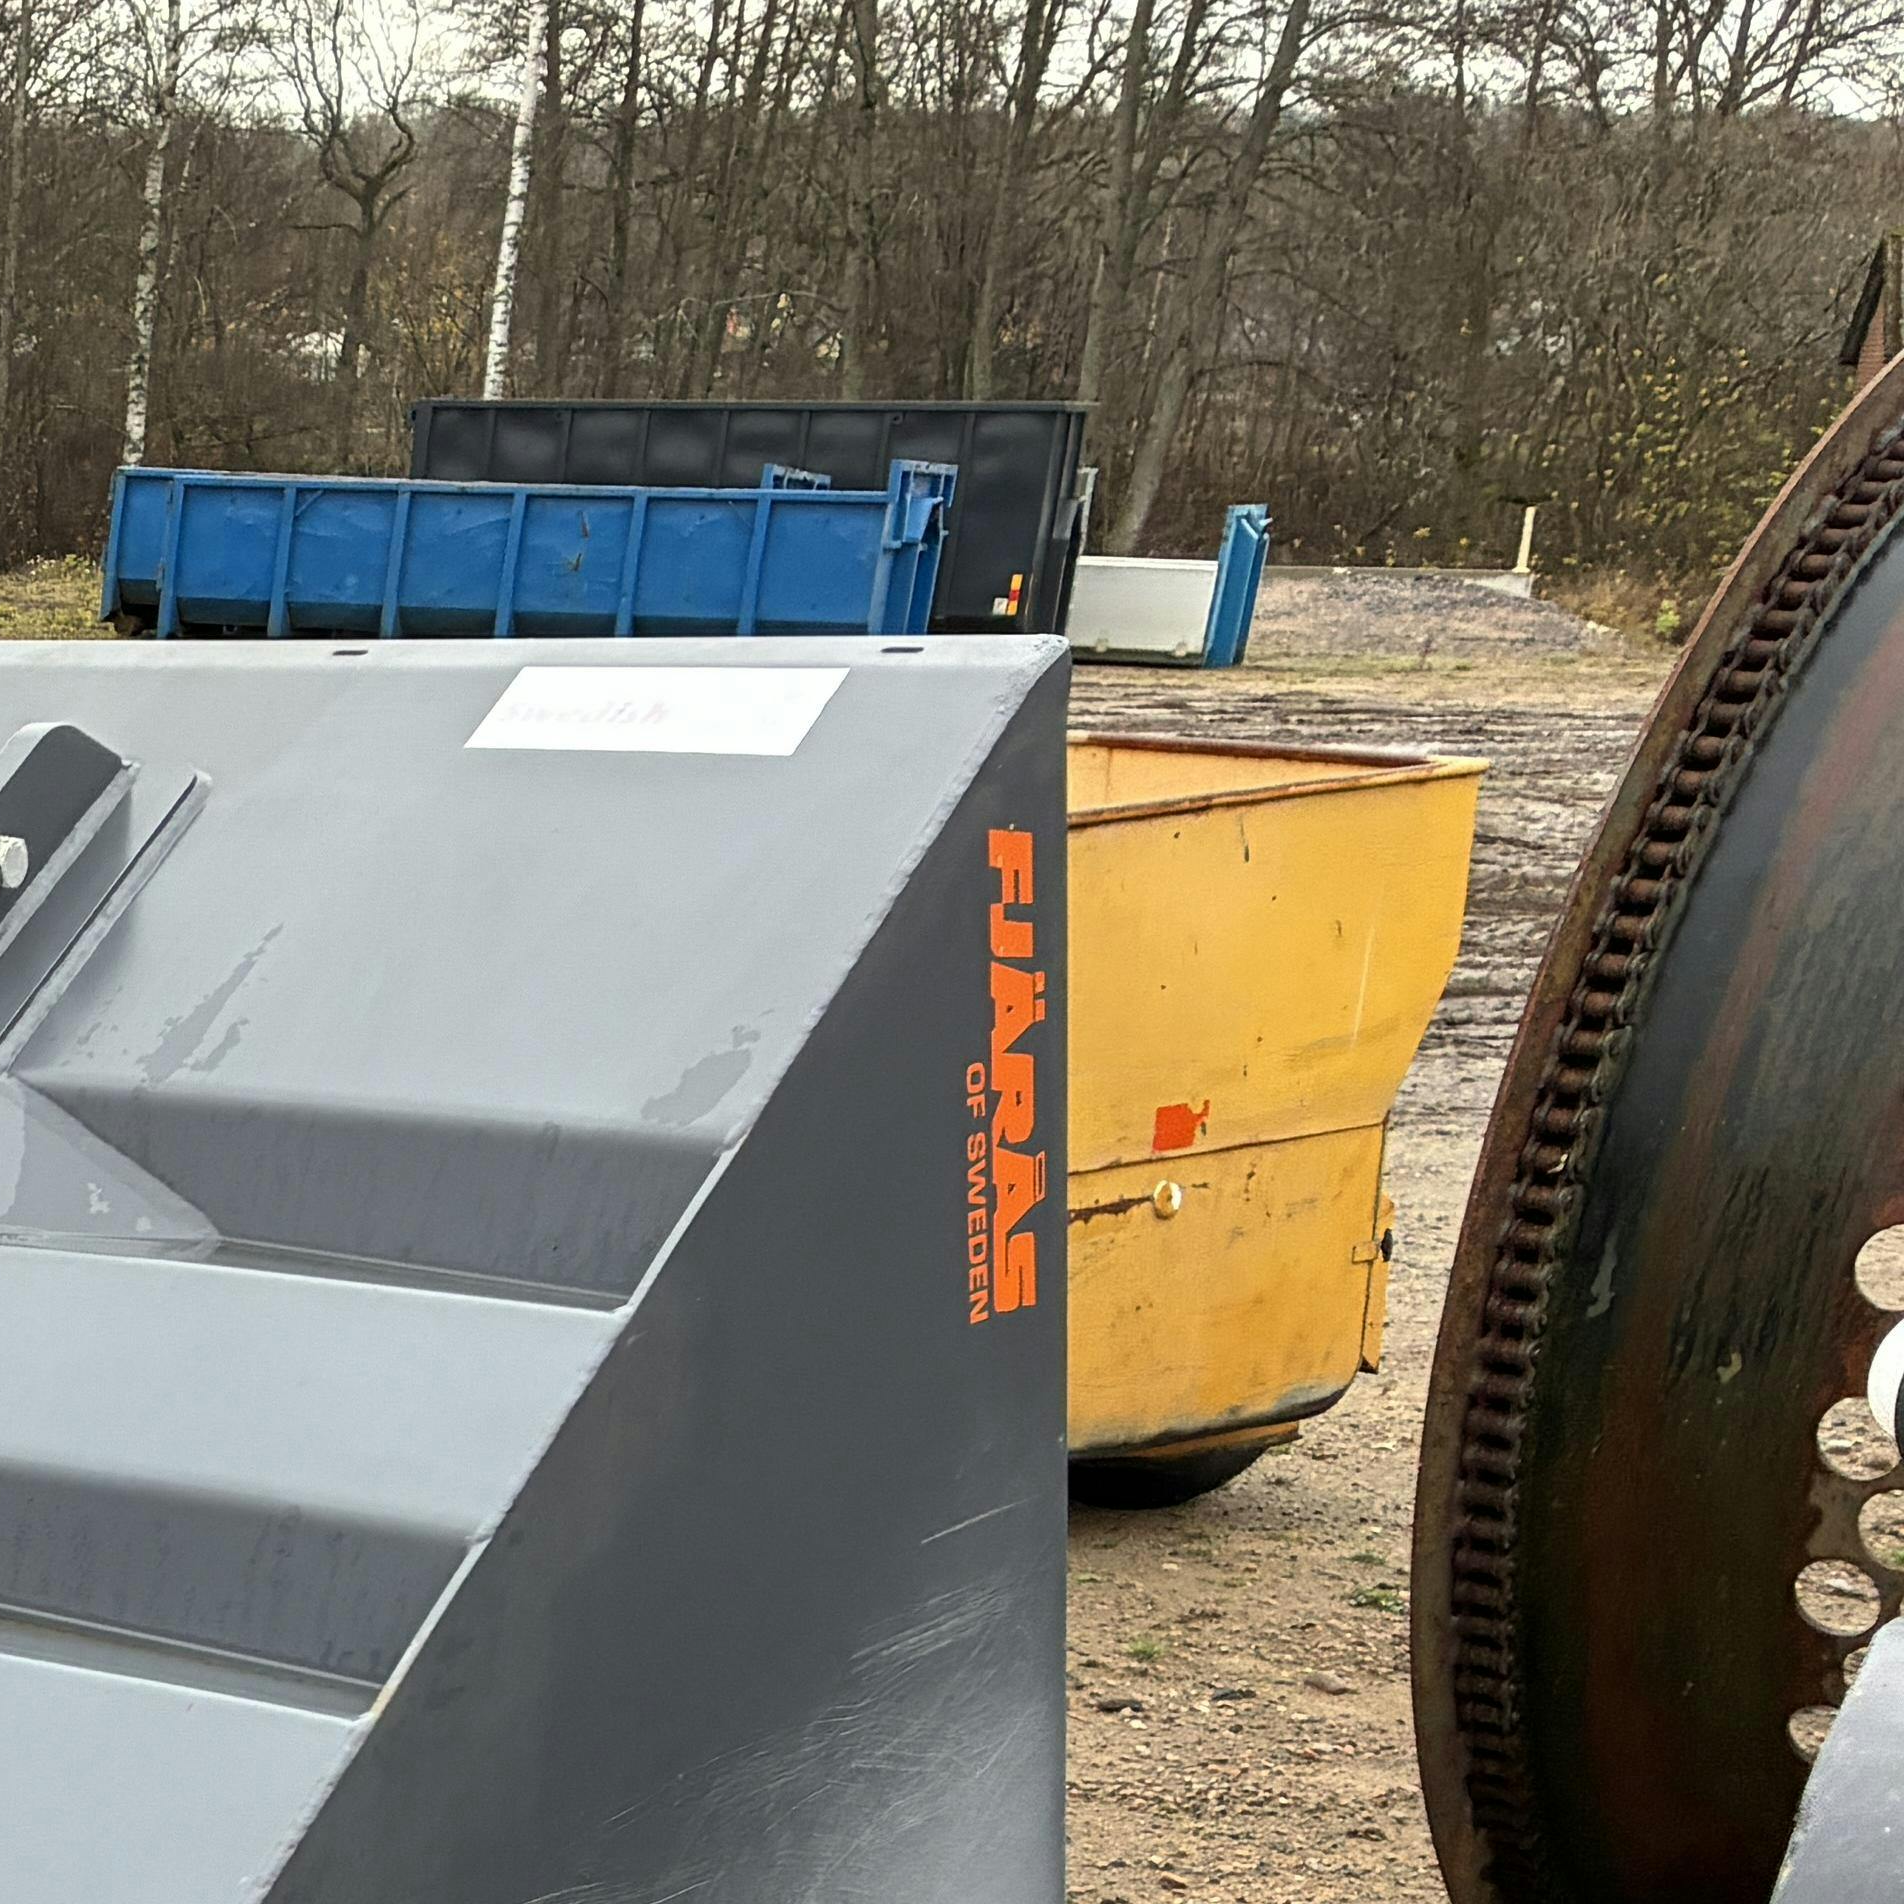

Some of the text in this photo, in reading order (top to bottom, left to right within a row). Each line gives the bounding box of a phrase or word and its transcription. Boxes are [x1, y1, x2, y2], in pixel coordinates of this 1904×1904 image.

[966, 1062, 991, 1325] OF SWEDEN
[988, 829, 1046, 1312] FJÄRÅS
